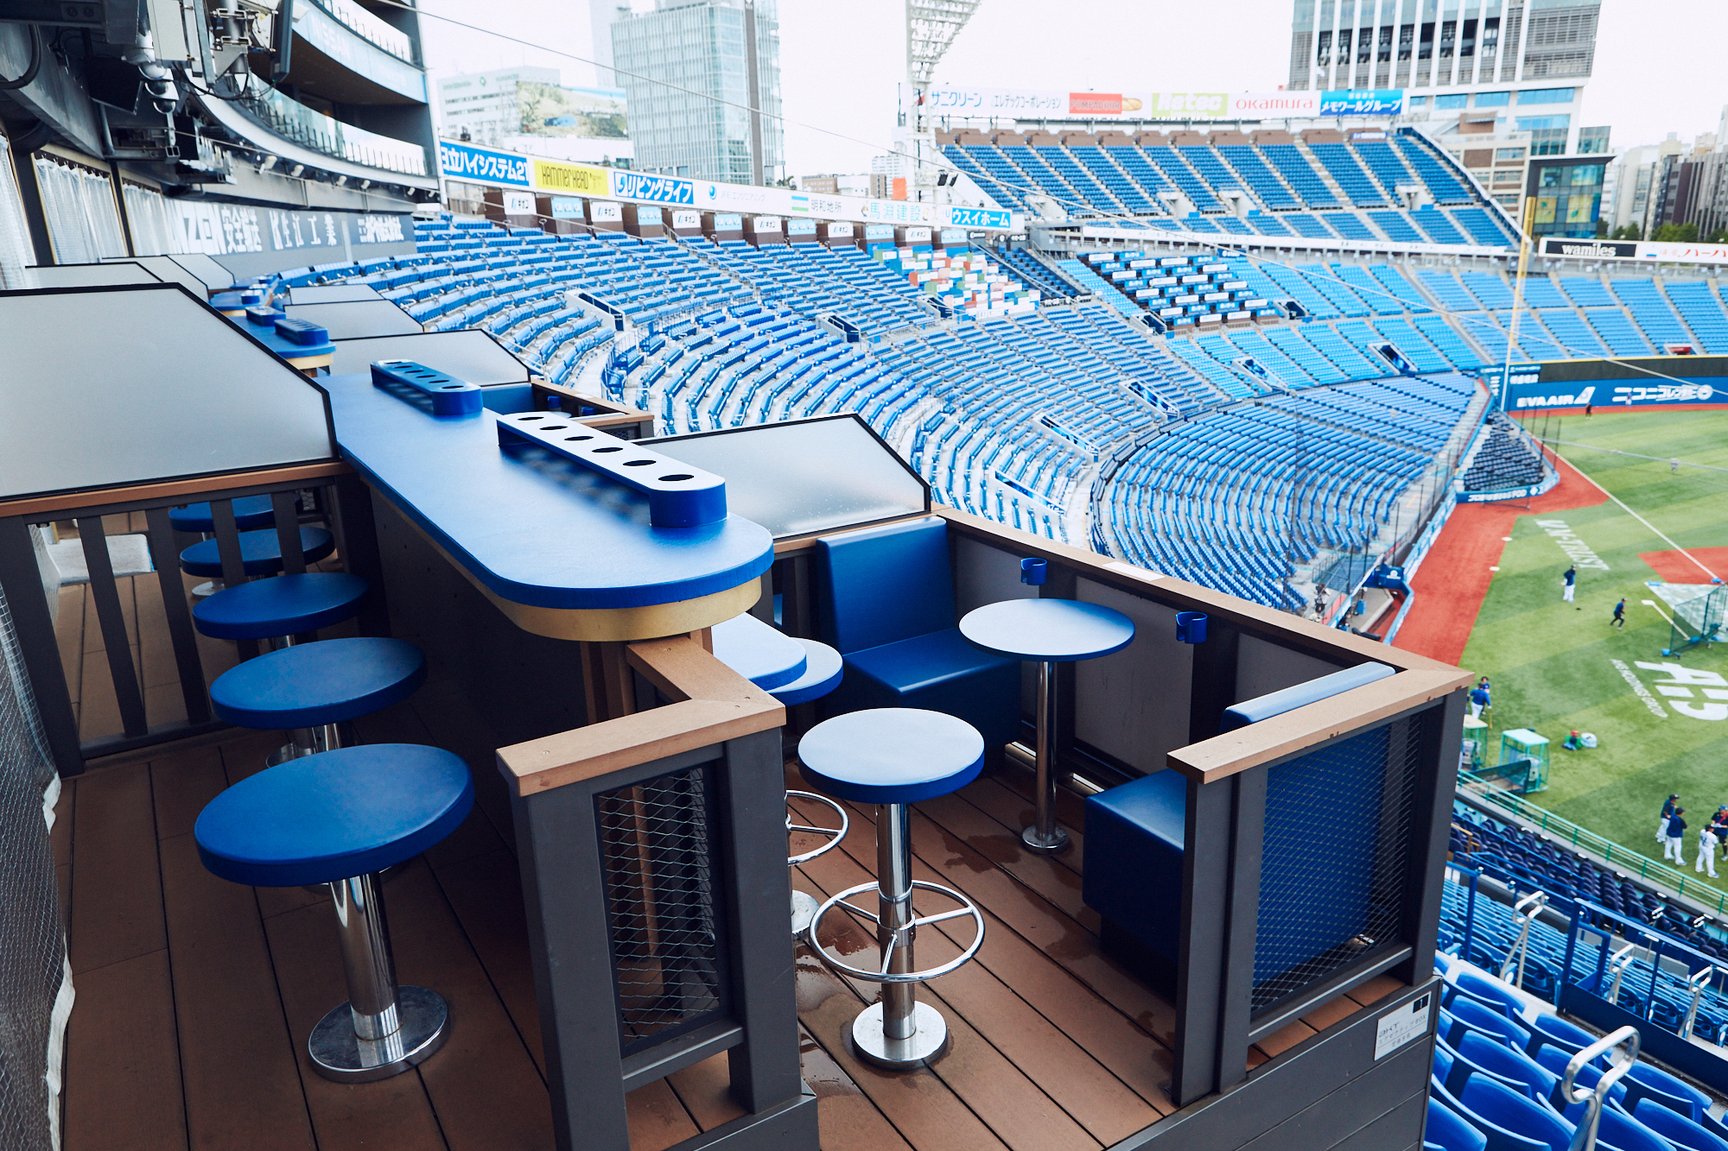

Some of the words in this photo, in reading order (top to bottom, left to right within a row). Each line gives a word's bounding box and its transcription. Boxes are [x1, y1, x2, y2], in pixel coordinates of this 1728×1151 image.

[931, 91, 982, 107] サニクリーン
[627, 177, 693, 204] リビングライフ
[953, 211, 1010, 227] ウスイホーム
[1562, 244, 1616, 257] wamiles
